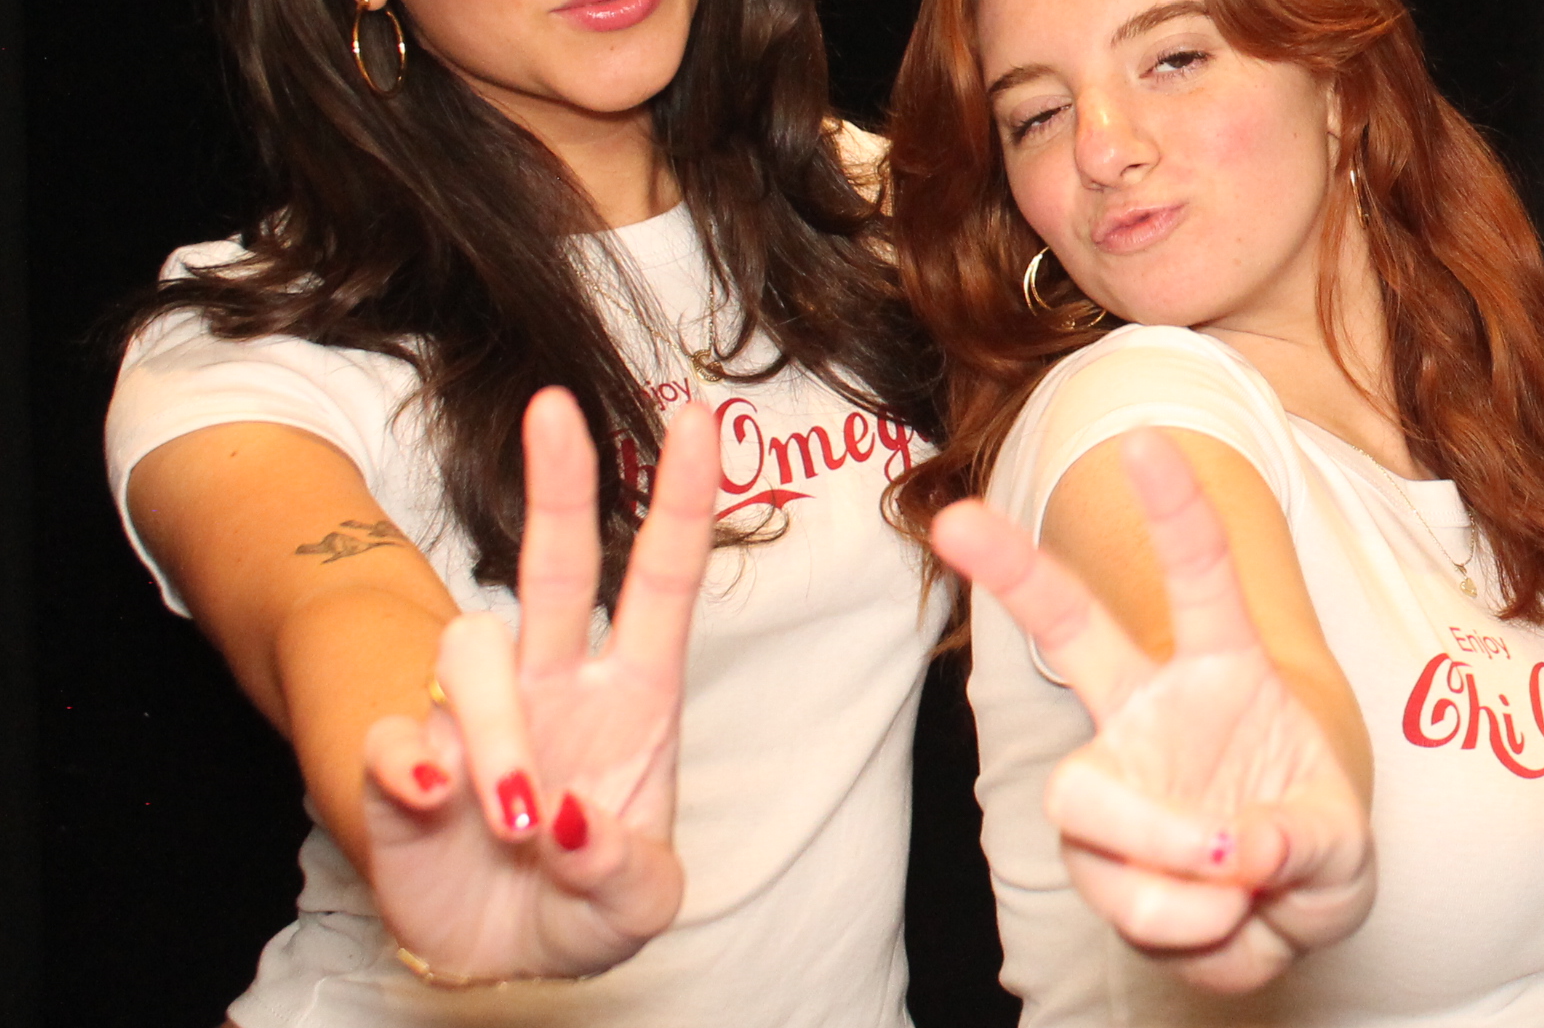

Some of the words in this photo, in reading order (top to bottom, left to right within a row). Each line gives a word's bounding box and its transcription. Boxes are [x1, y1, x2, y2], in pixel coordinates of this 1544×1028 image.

[641, 377, 692, 412] joy
[714, 397, 929, 495] Omeg
[1449, 626, 1511, 660] Enjoy
[1402, 652, 1534, 779] Chi
